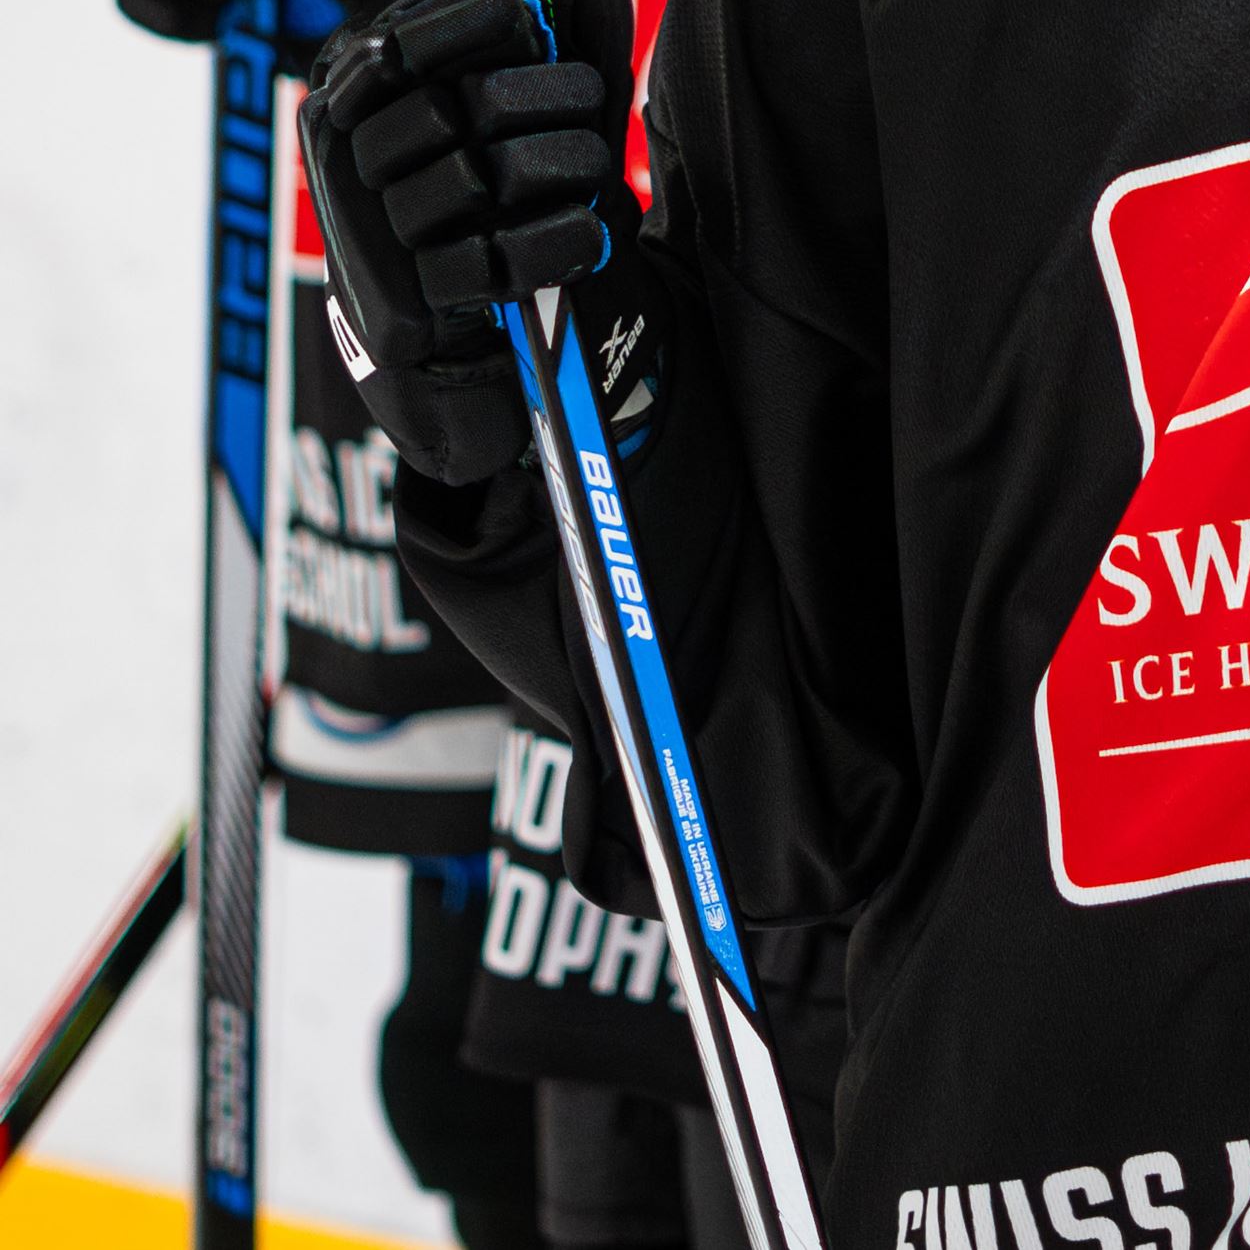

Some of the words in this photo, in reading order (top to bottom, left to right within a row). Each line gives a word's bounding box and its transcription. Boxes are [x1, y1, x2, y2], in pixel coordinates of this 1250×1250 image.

[1107, 651, 1197, 704] ICE
[680, 778, 698, 821] MADE
[691, 823, 703, 840] IN
[681, 820, 693, 841] EN
[687, 843, 711, 906] UKRAINE
[696, 841, 721, 904] UKRAINE
